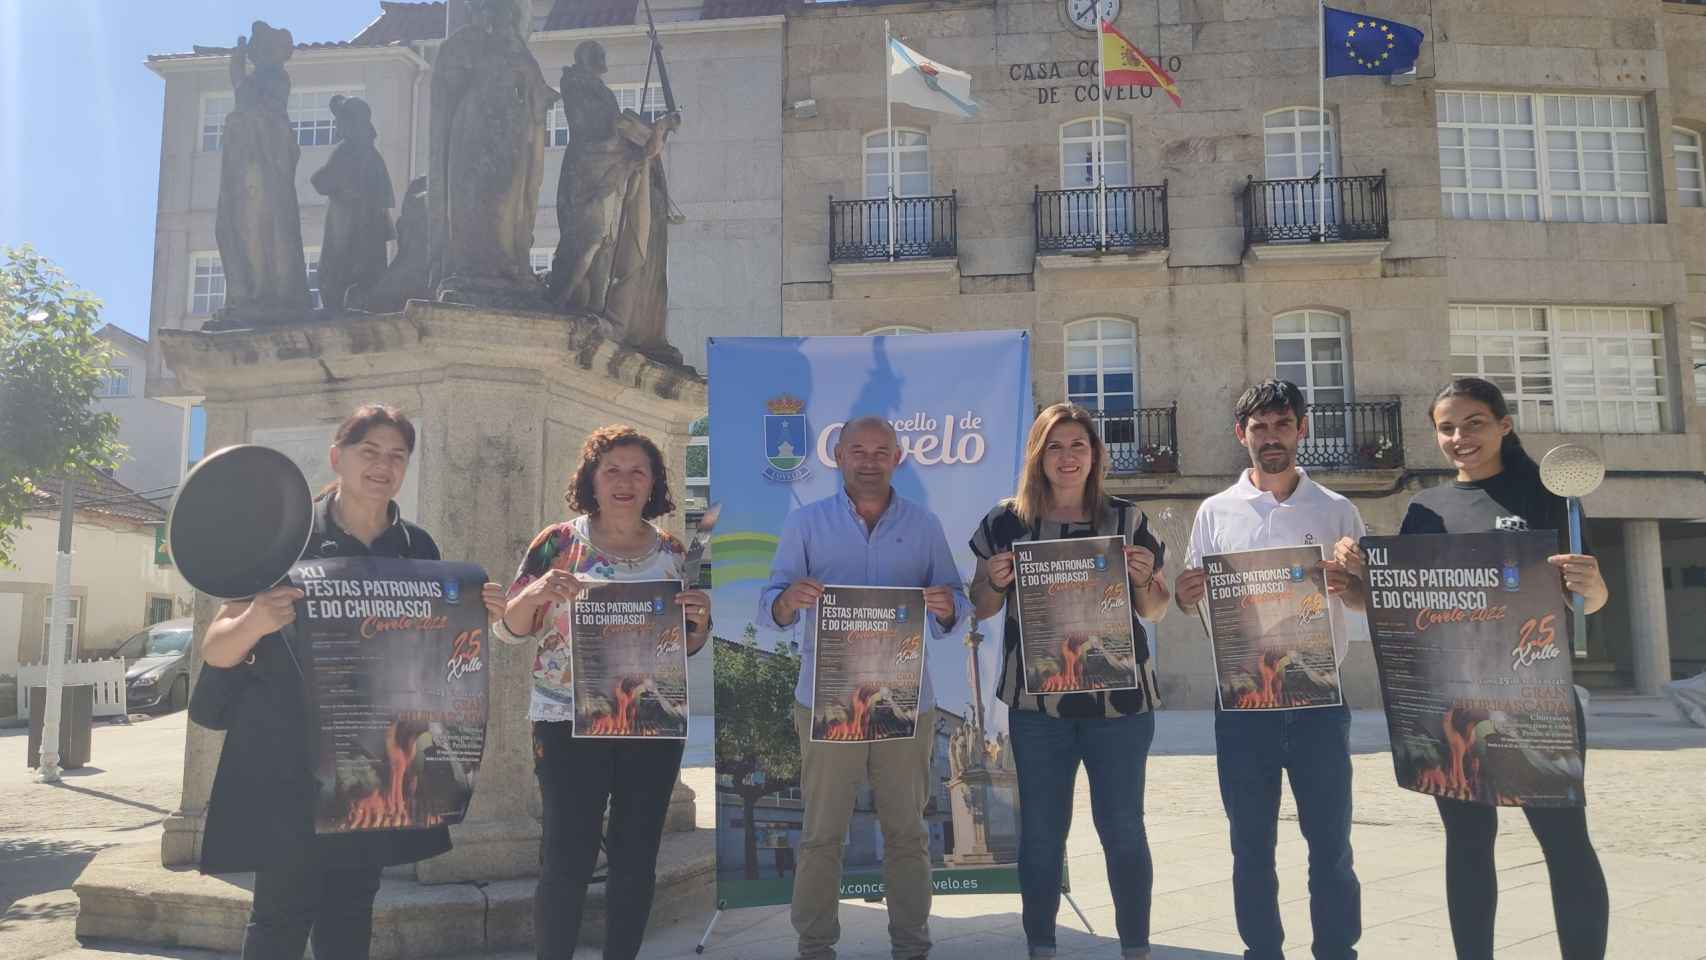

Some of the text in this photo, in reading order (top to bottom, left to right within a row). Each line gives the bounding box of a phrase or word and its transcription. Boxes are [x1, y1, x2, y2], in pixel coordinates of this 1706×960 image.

[1009, 62, 1061, 81] CASA
[1038, 84, 1153, 104] DE COVELO
[888, 411, 982, 431] cello de
[817, 415, 985, 468] Cvelo
[1019, 551, 1032, 561] XLI
[1366, 548, 1388, 566] XLI
[299, 566, 326, 578] XLI
[1020, 558, 1095, 574] FESTAS PATRONAIS
[1208, 562, 1222, 574] XLI
[1022, 571, 1089, 587] E DO CHURRASCO
[1210, 568, 1291, 587] FESTAS PATRONAIS
[1369, 568, 1499, 588] FESTAS PATRONAIS
[304, 580, 442, 598] FESTAS PATRONAIS
[1212, 582, 1284, 600] E DO CHURRASCO
[575, 601, 653, 613] FESTAS PATRONAIS
[823, 594, 836, 605] XLI
[1372, 591, 1487, 609] E DO CHURRASCO
[307, 600, 432, 618] E DO CHURRASCO
[822, 607, 896, 619] FESTAS PATRONAIS
[575, 615, 645, 625] E DO CHURRASCO
[822, 620, 888, 632] E DO CHURRASCO
[1519, 611, 1557, 648] 25
[449, 628, 482, 658] 25
[1512, 643, 1561, 671] Xullo
[447, 655, 483, 683] Xullo
